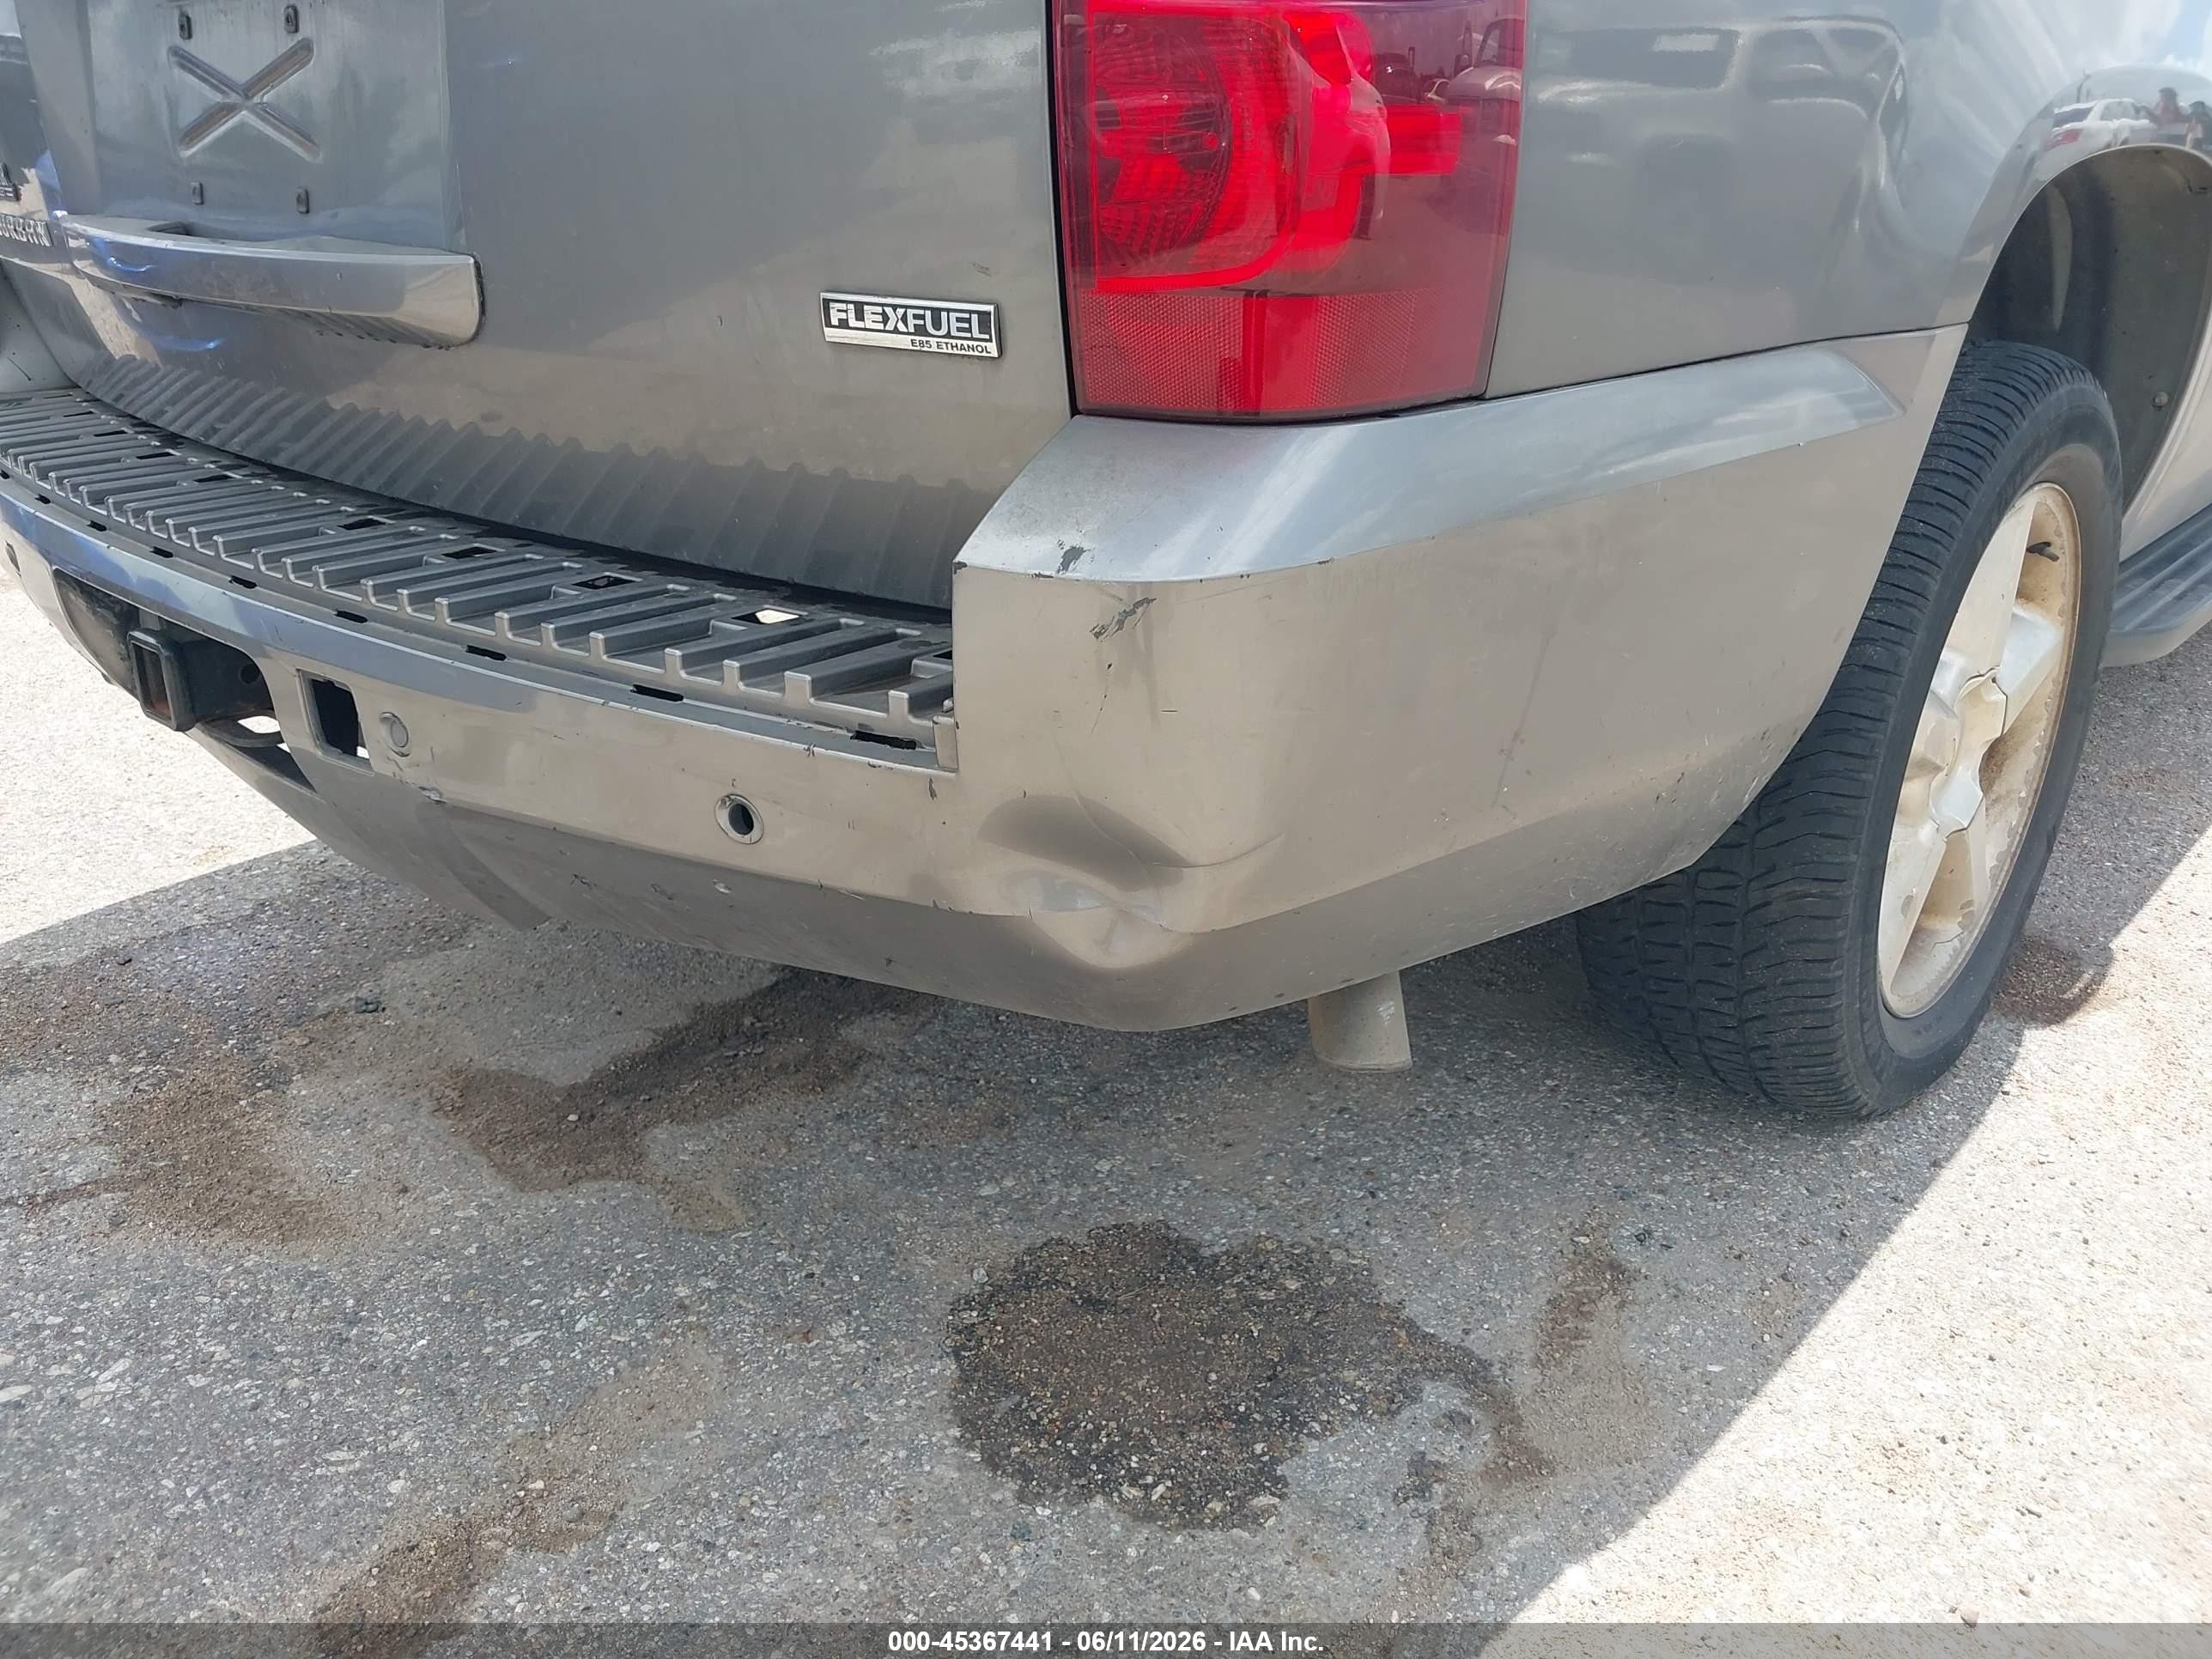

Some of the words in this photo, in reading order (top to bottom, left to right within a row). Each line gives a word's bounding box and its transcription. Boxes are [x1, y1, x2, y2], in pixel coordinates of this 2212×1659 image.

[0, 213, 51, 247] URBAN
[829, 301, 990, 340] FLEXFUEL
[910, 338, 933, 349] E85
[936, 341, 992, 355] ETHANOL
